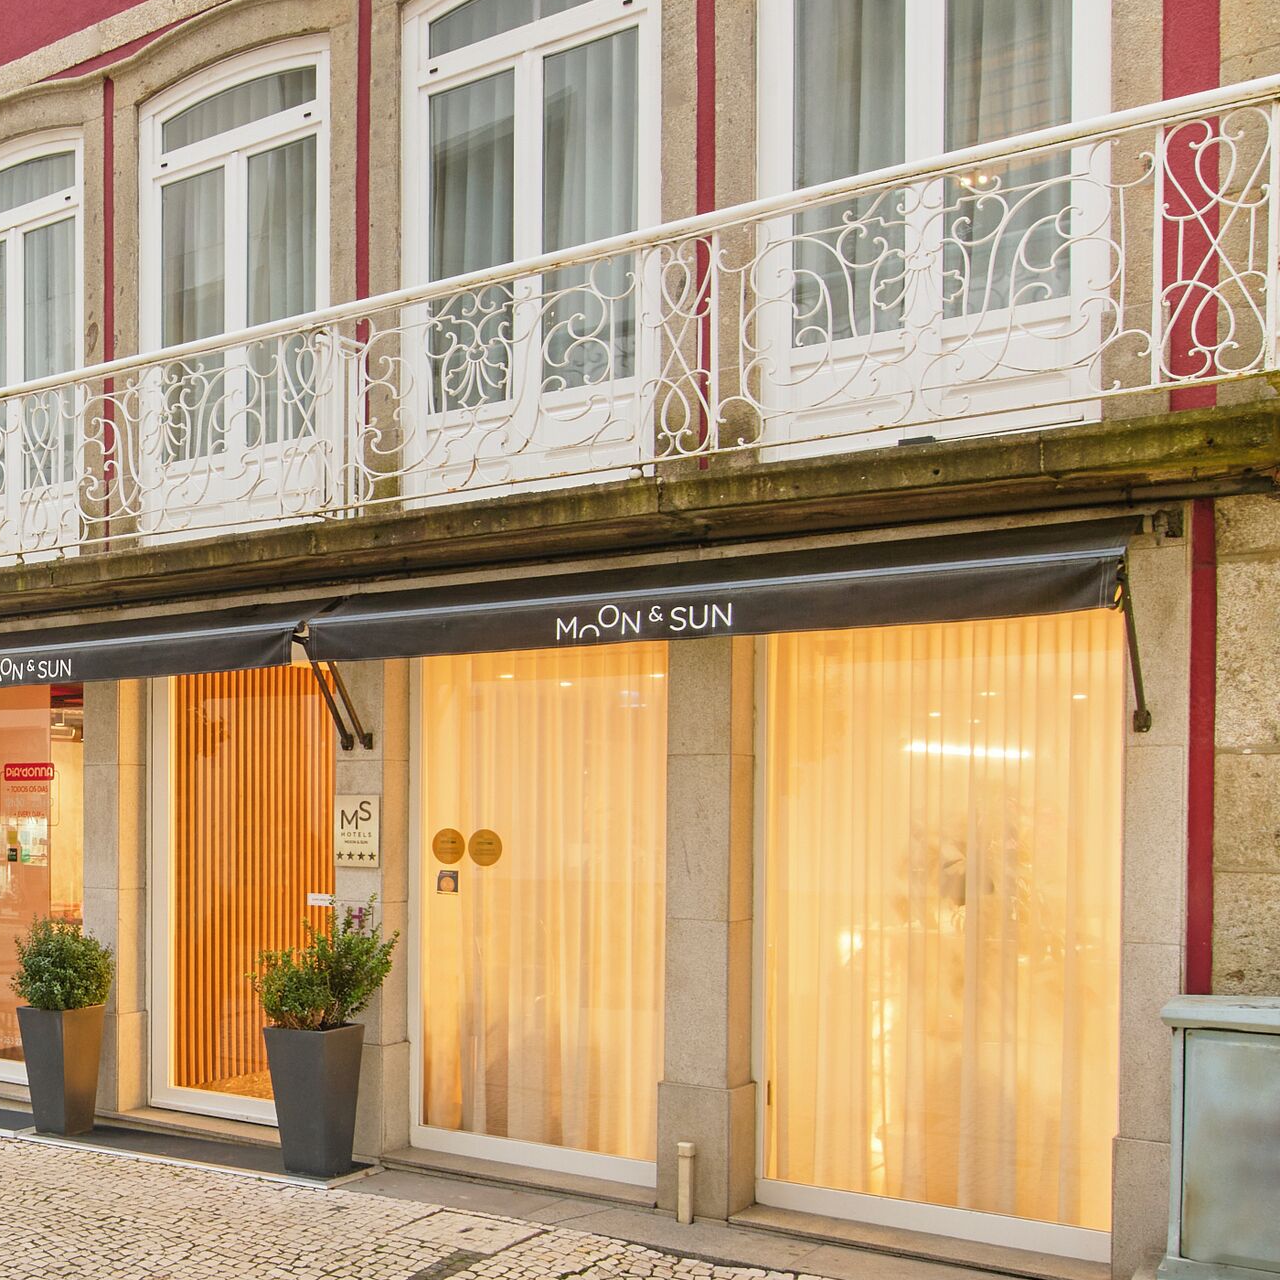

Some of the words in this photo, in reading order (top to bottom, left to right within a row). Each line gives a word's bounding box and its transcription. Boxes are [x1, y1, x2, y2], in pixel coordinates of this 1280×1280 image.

[556, 604, 641, 641] MOON
[648, 605, 664, 623] &
[669, 602, 732, 631] SUN
[26, 659, 36, 672] &
[37, 658, 72, 679] SUN
